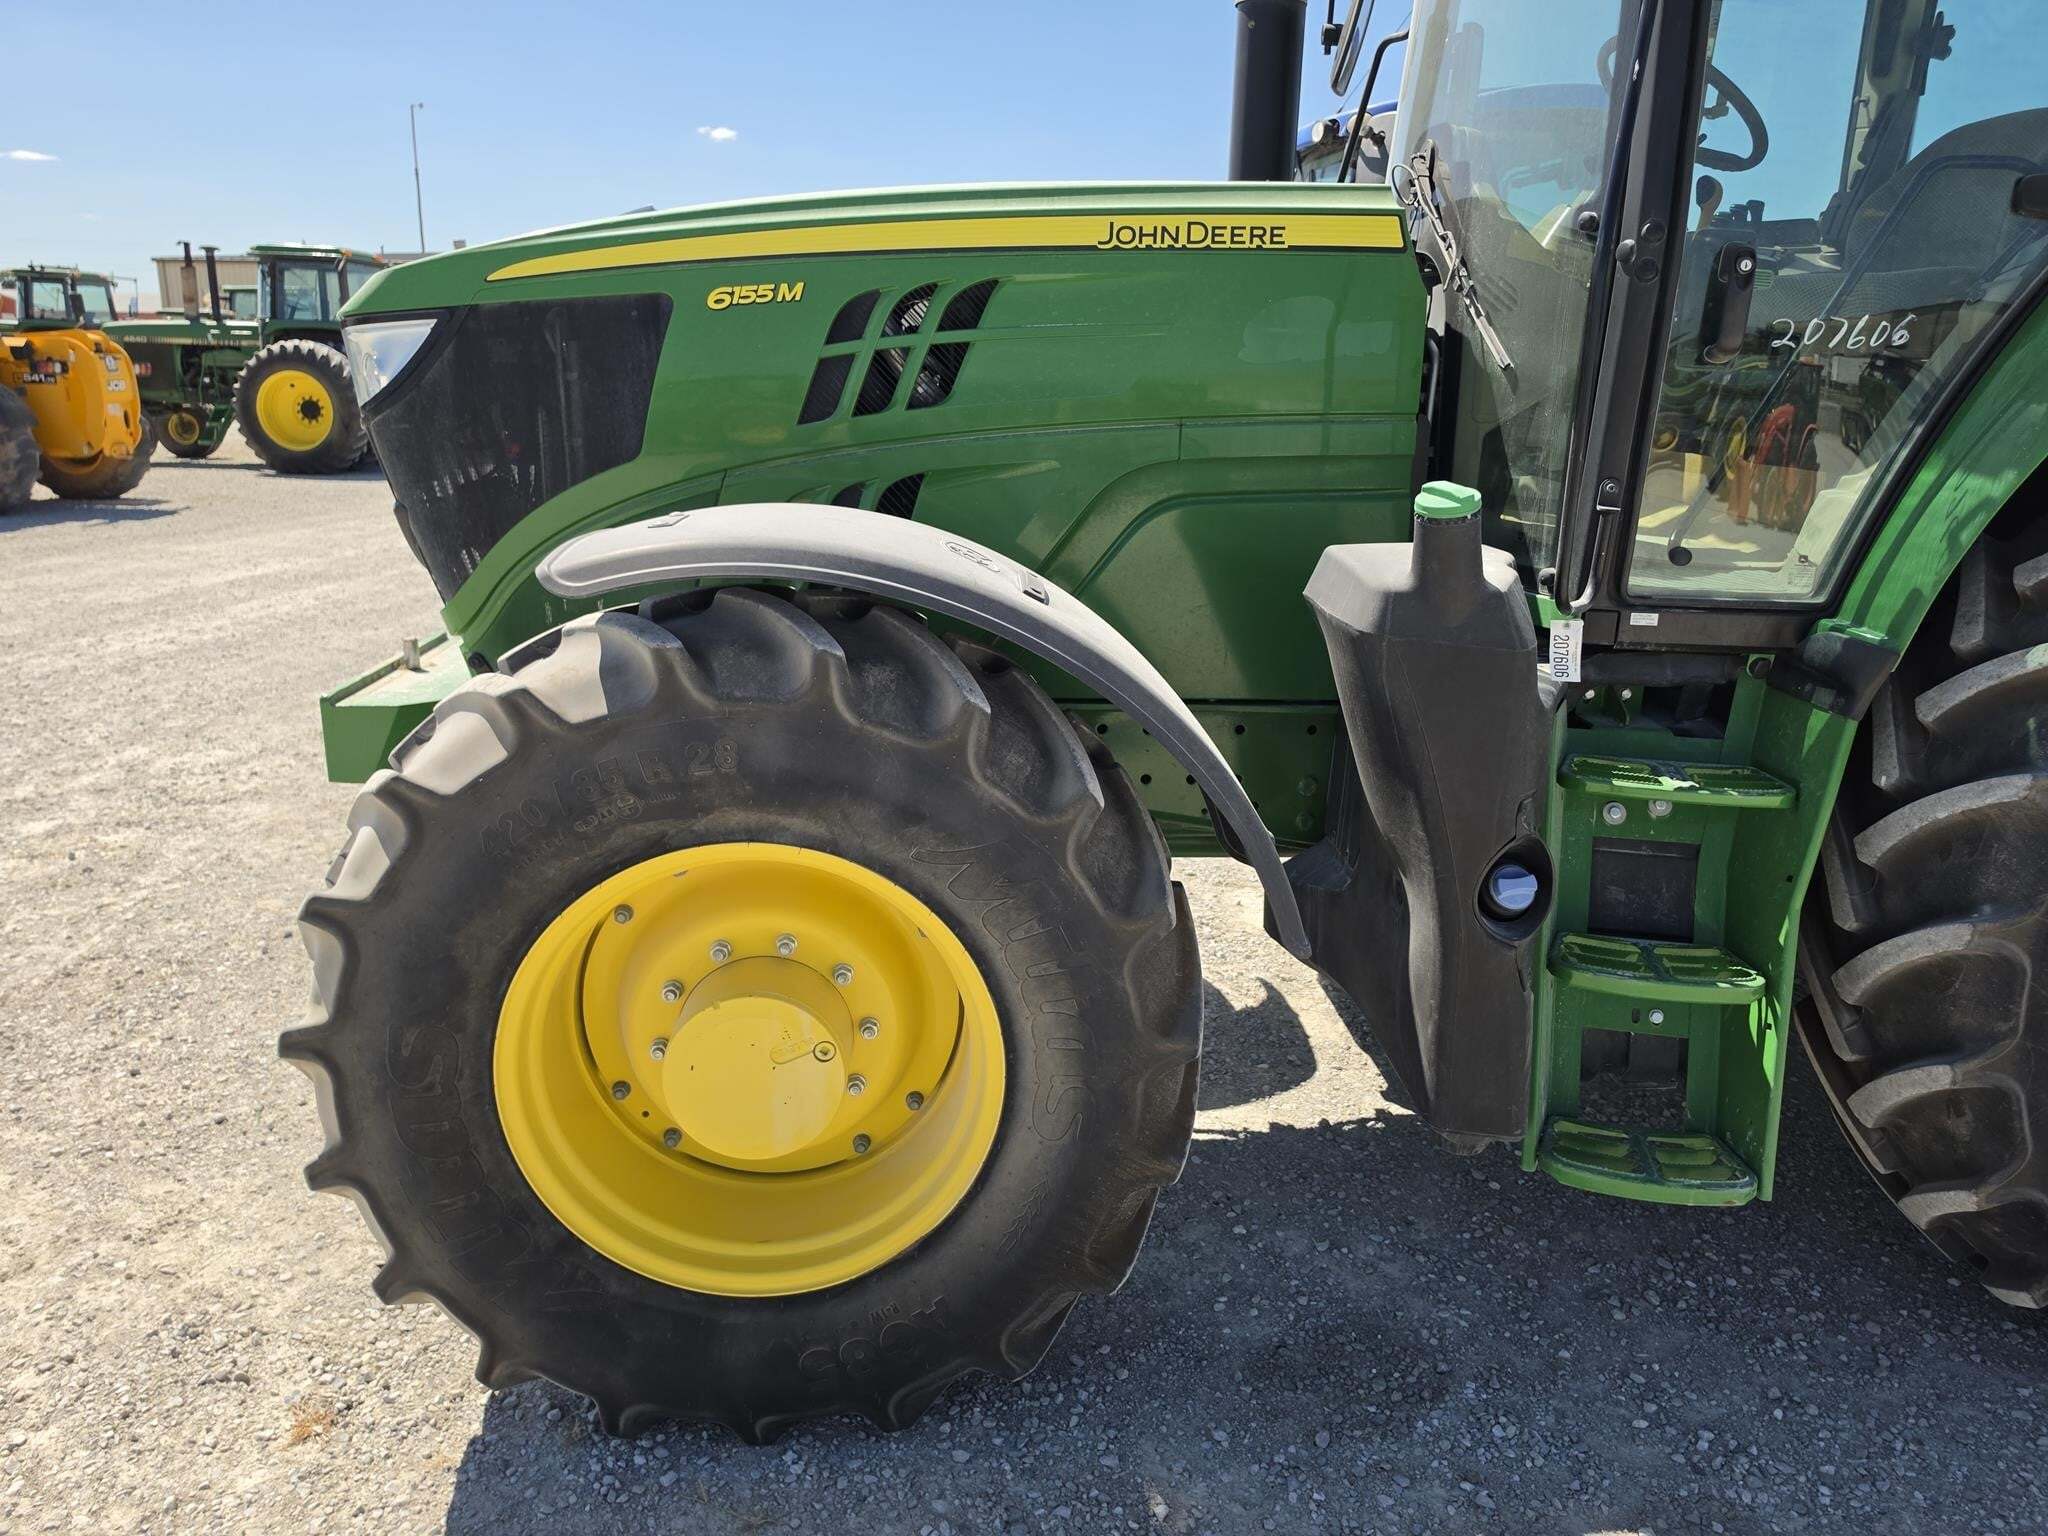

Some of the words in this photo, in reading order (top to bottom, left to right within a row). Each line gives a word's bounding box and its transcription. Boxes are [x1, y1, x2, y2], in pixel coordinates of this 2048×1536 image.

[1098, 221, 1180, 245] JOHN
[1186, 221, 1286, 245] DEERE
[1770, 313, 1918, 350] 207606
[1551, 634, 1569, 678] 207606
